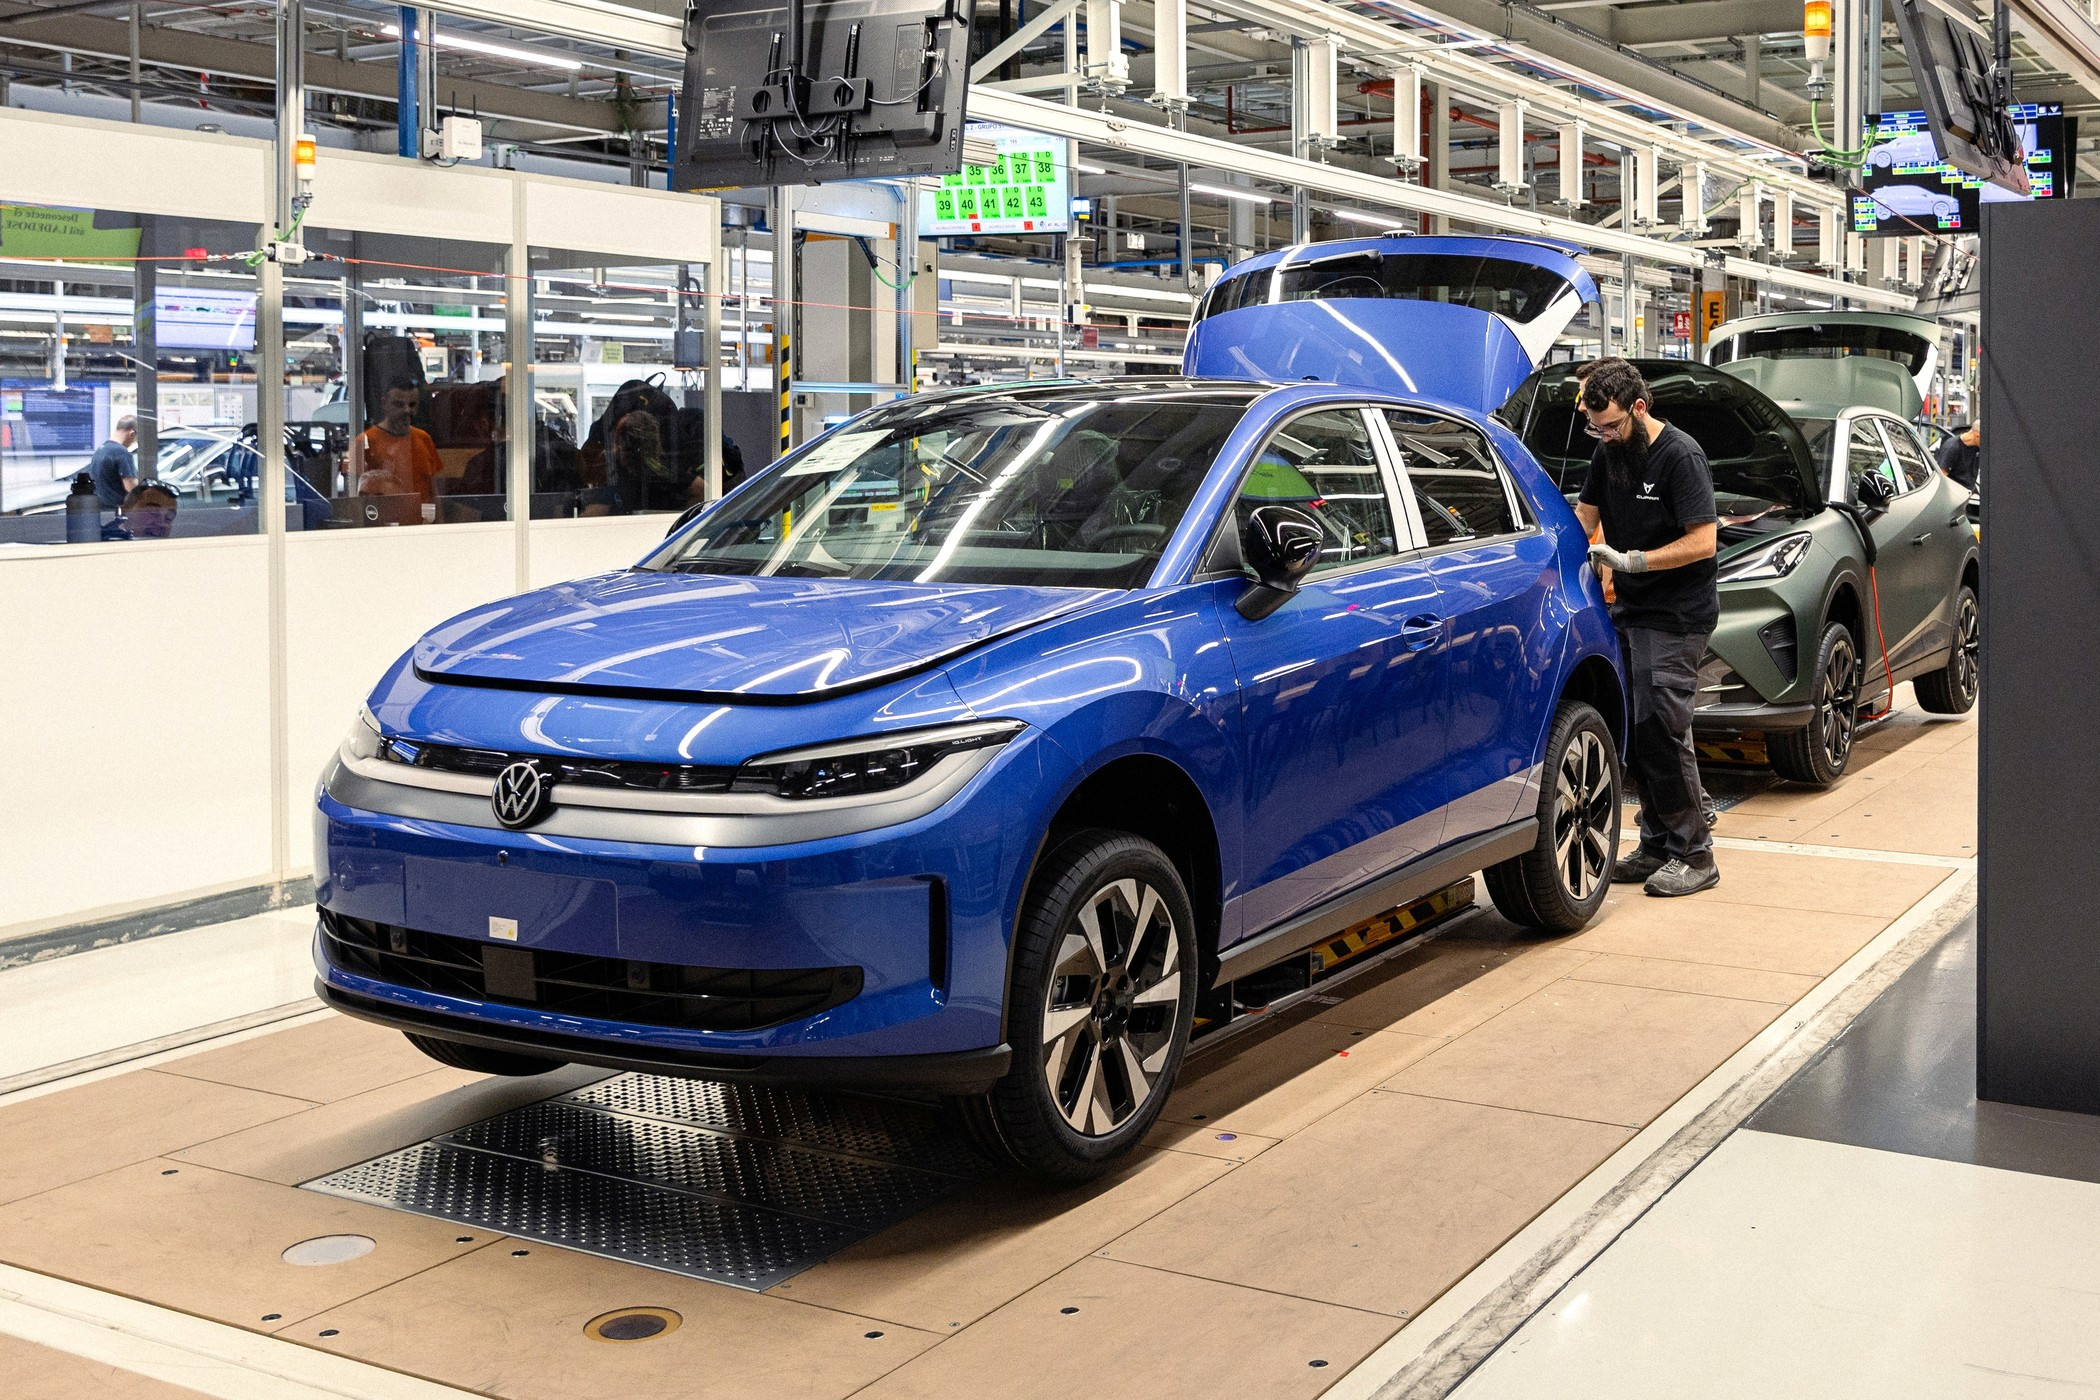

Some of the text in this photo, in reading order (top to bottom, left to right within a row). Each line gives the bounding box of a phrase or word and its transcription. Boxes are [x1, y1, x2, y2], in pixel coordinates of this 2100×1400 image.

[969, 165, 981, 176] 35
[992, 164, 1004, 175] 36
[1015, 163, 1027, 174] 37
[1038, 162, 1051, 173] 38
[939, 200, 951, 211] 39
[961, 200, 974, 210] 40
[984, 199, 996, 209] 41
[1007, 198, 1019, 208] 42
[1030, 197, 1043, 207] 43
[1709, 301, 1720, 319] E
[495, 764, 540, 821] VW
